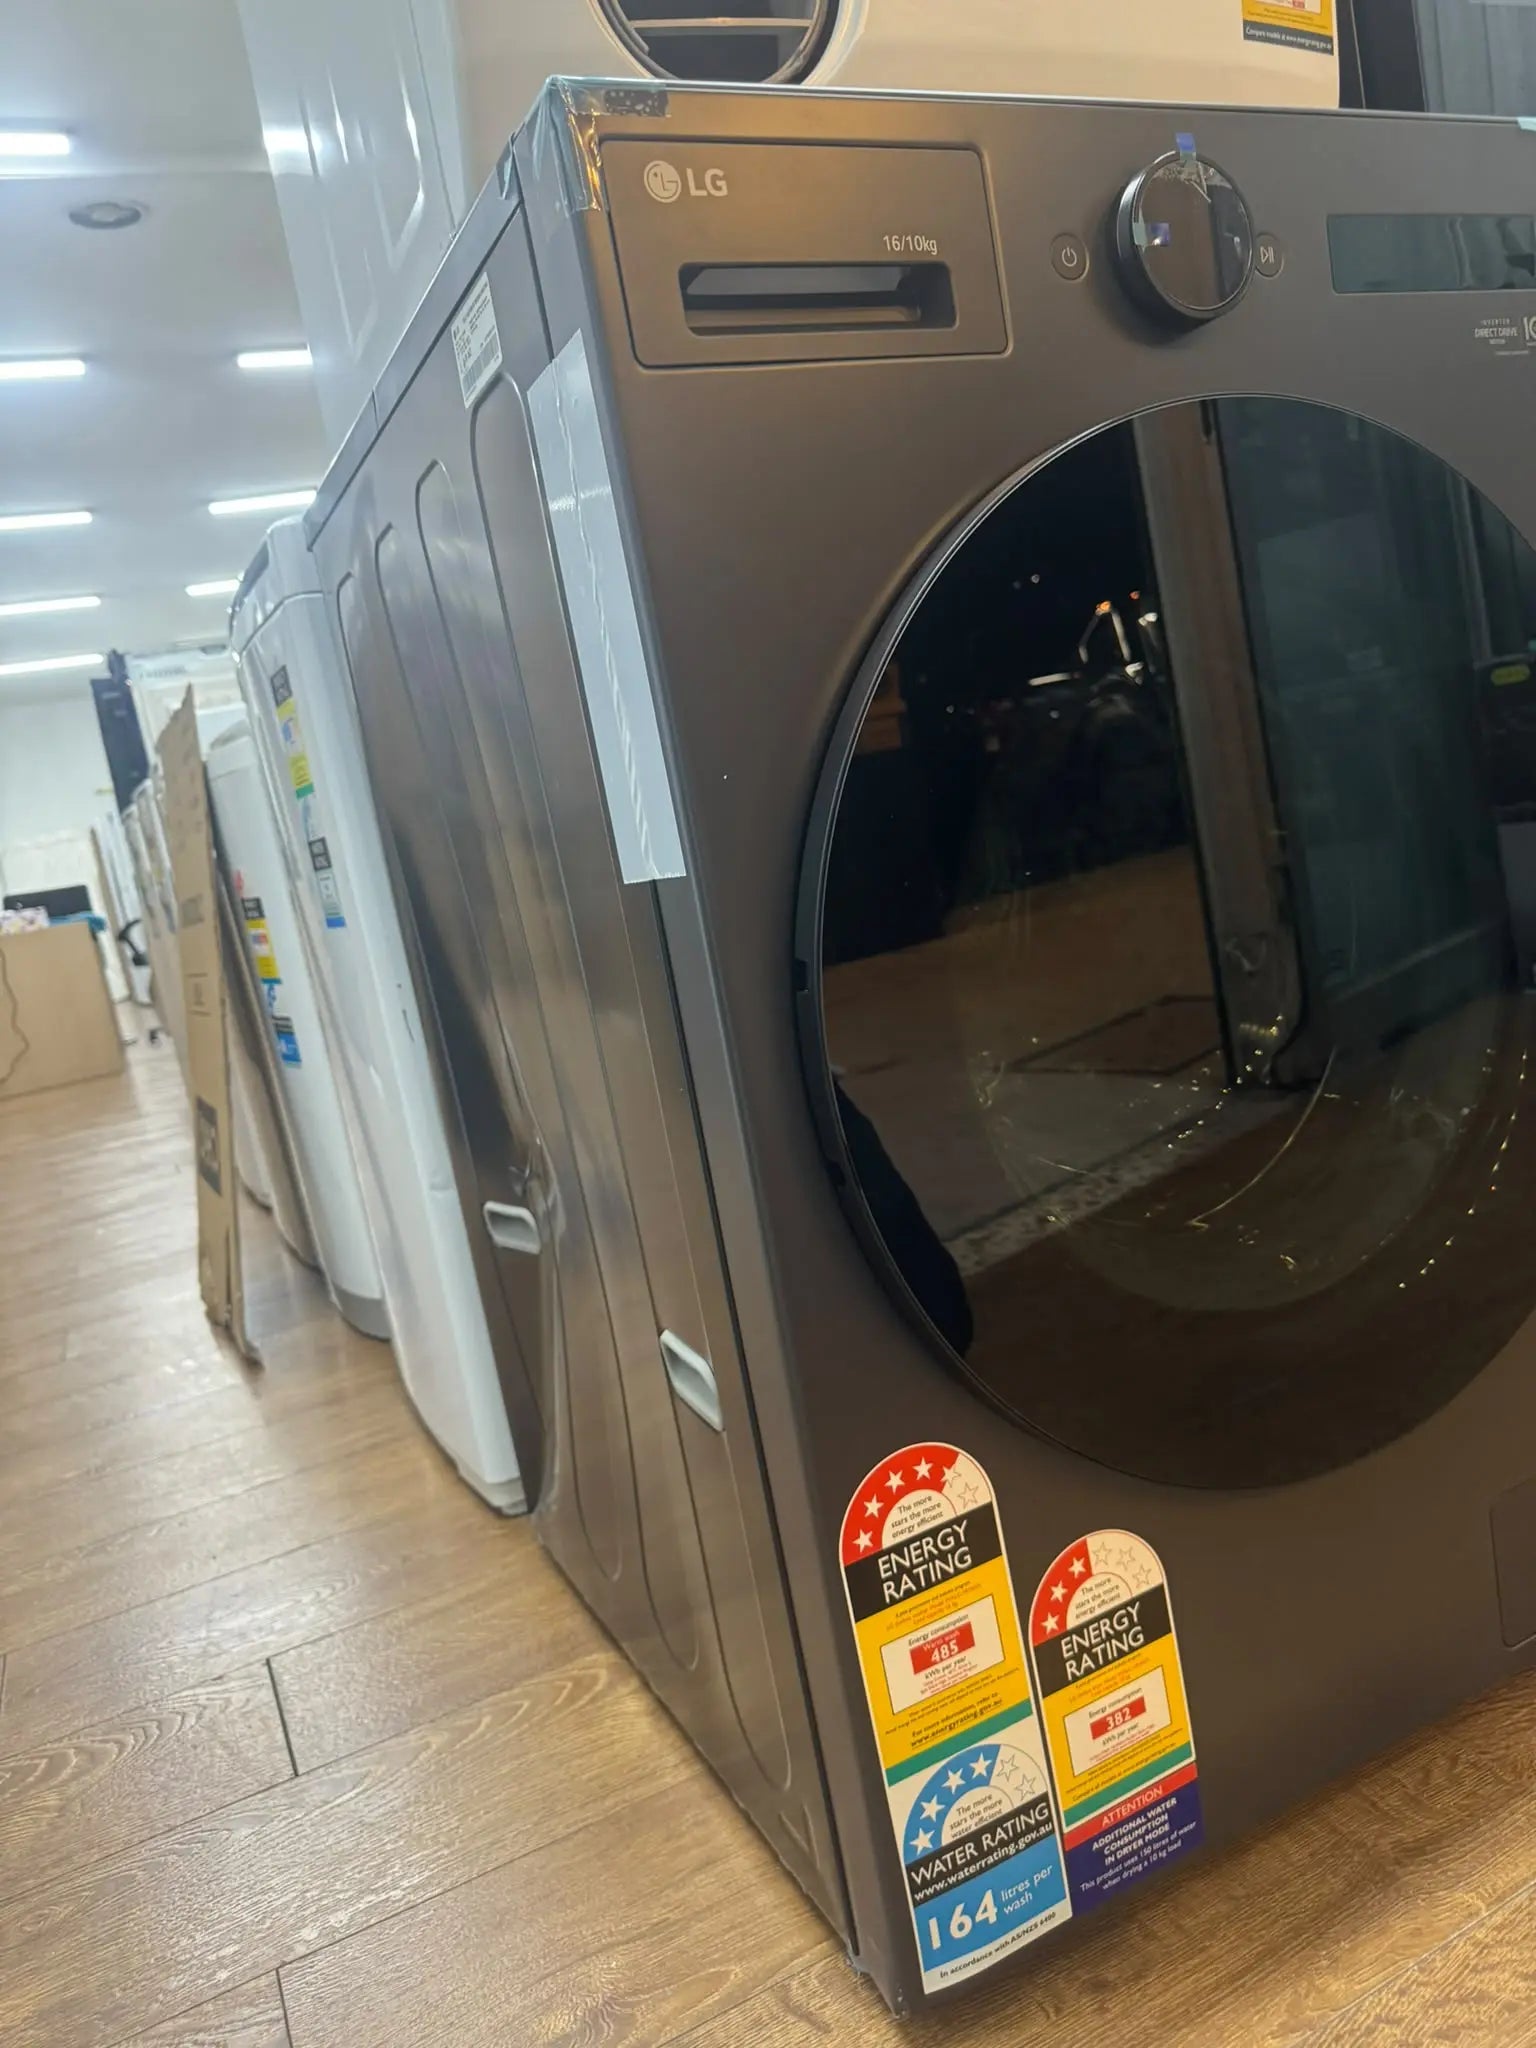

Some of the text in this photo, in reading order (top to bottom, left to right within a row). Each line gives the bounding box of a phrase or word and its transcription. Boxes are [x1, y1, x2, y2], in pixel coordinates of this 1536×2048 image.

[686, 167, 728, 197] LG
[883, 235, 938, 255] 16/10kg
[891, 1502, 941, 1528] stars the more
[898, 1495, 932, 1514] The more
[892, 1512, 944, 1538] energy efficient
[878, 1520, 968, 1579] ENERGY
[883, 1547, 972, 1604] RATING
[1081, 1578, 1111, 1595] The more
[1091, 1592, 1102, 1603] the
[1103, 1584, 1120, 1596] more
[908, 1632, 929, 1646] Energy
[931, 1614, 969, 1636] consumption
[1061, 1601, 1140, 1659] ENERGY
[931, 1640, 959, 1662] 485
[1065, 1625, 1145, 1680] RATING
[924, 1667, 940, 1680] kWh
[941, 1663, 952, 1674] per
[1106, 1707, 1132, 1731] 382
[950, 1799, 1003, 1830] stars the more
[956, 1794, 993, 1816] The more
[1102, 1785, 1163, 1828] ATTENTION
[951, 1809, 1003, 1839] water efficient
[1092, 1797, 1177, 1851] ADDITIONAL WATER
[1104, 1813, 1168, 1855] CONSUMPTION
[911, 1803, 1049, 1885] WATER RATING
[914, 1822, 1052, 1901] www.waterrating.gov.au
[1080, 1880, 1095, 1892] This
[1096, 1864, 1123, 1885] product
[1124, 1856, 1138, 1866] uses
[1140, 1845, 1152, 1857] 150
[1170, 1830, 1178, 1840] of
[1105, 1822, 1170, 1866] IN DRYER MODE
[1102, 1877, 1121, 1890] when
[1122, 1862, 1143, 1878] drying
[1168, 1839, 1182, 1852] load
[1001, 1864, 1053, 1902] litres per
[929, 1889, 998, 1950] 164
[1003, 1891, 1033, 1915] wash
[940, 1970, 949, 1978] In
[950, 1952, 993, 1975] accordance
[994, 1940, 1010, 1953] with
[1010, 1923, 1039, 1945] AS/NZS
